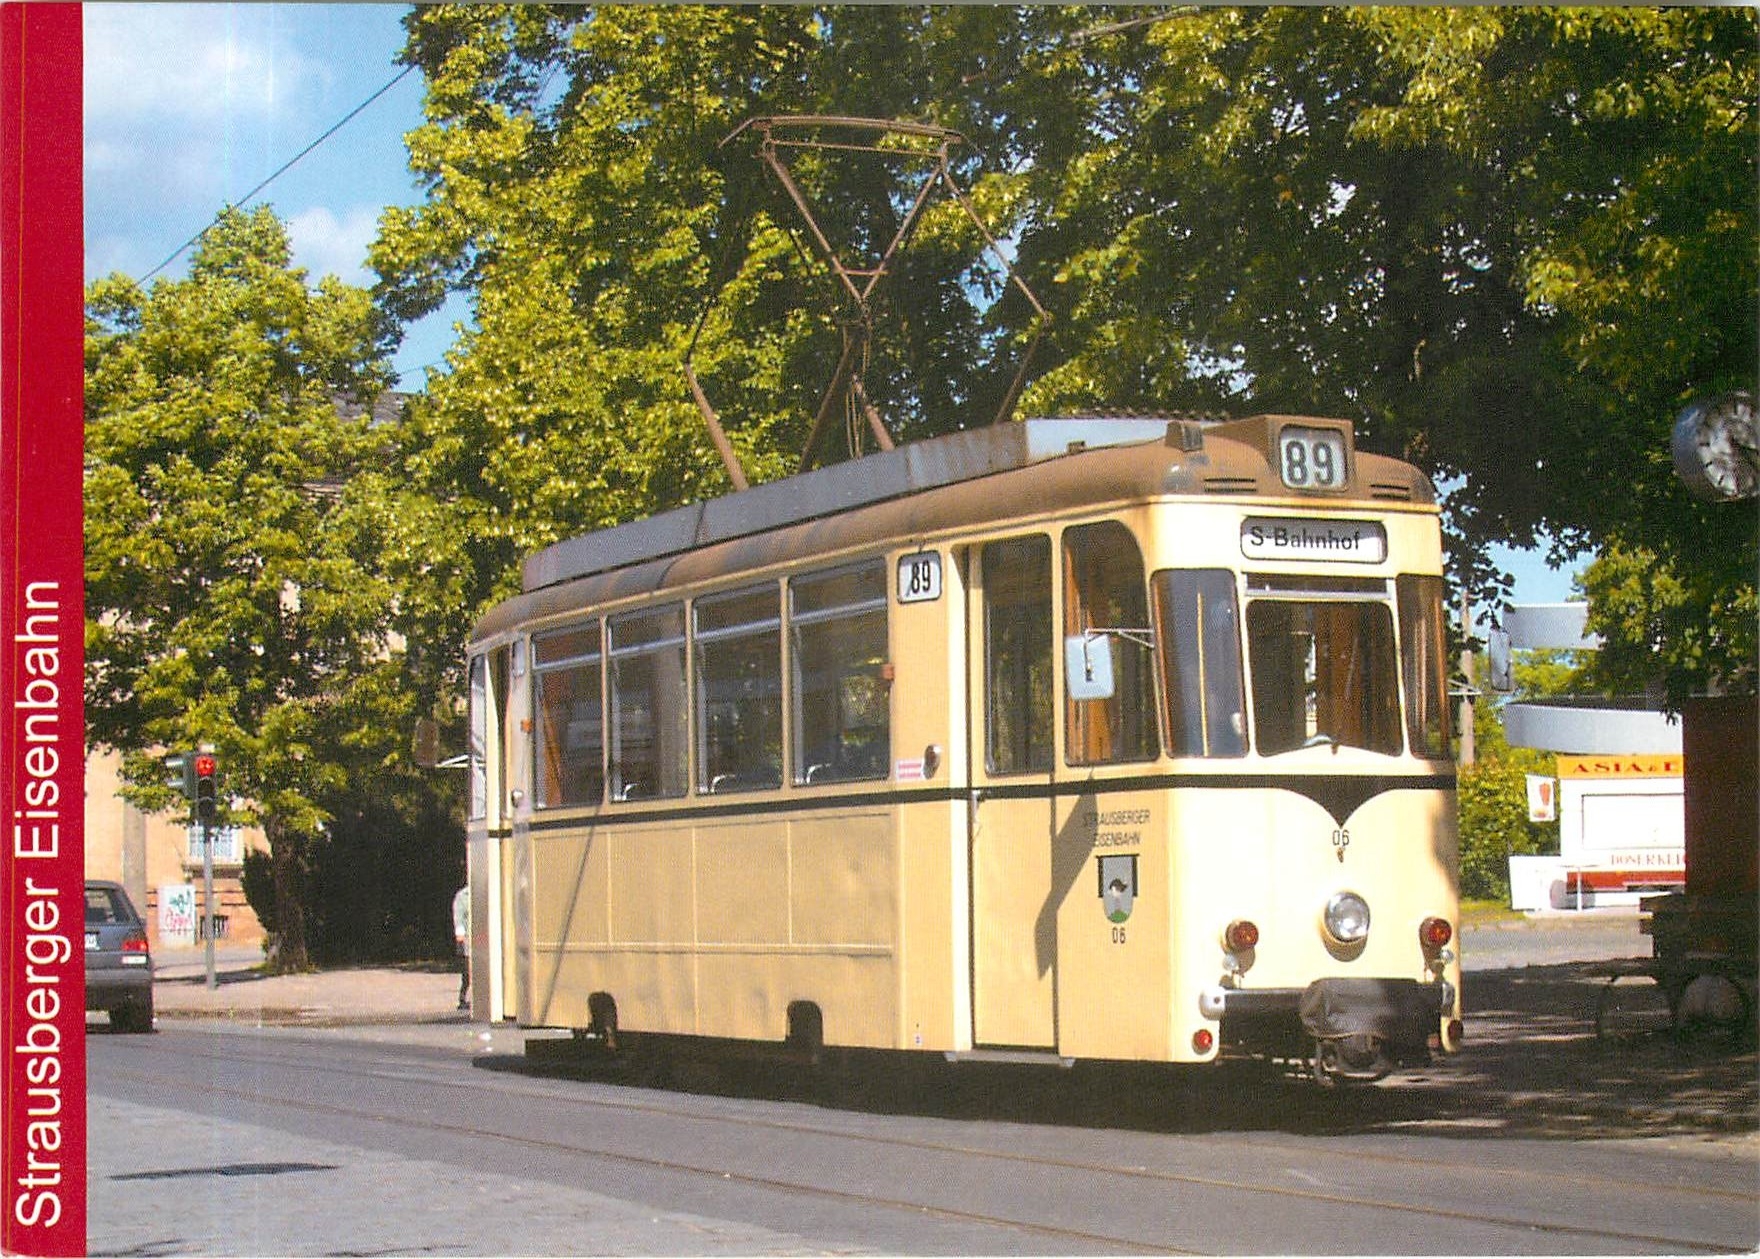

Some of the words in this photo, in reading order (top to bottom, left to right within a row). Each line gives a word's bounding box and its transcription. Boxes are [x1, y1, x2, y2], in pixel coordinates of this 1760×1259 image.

[1286, 439, 1334, 486] 89
[1250, 525, 1360, 551] S-Bahnhof
[911, 560, 932, 594] 89
[1573, 762, 1642, 773] ASIA
[1083, 808, 1150, 826] STRAUSBERGER
[1088, 831, 1140, 847] EISENBAHN
[1332, 829, 1350, 846] 06
[1112, 926, 1126, 944] 06
